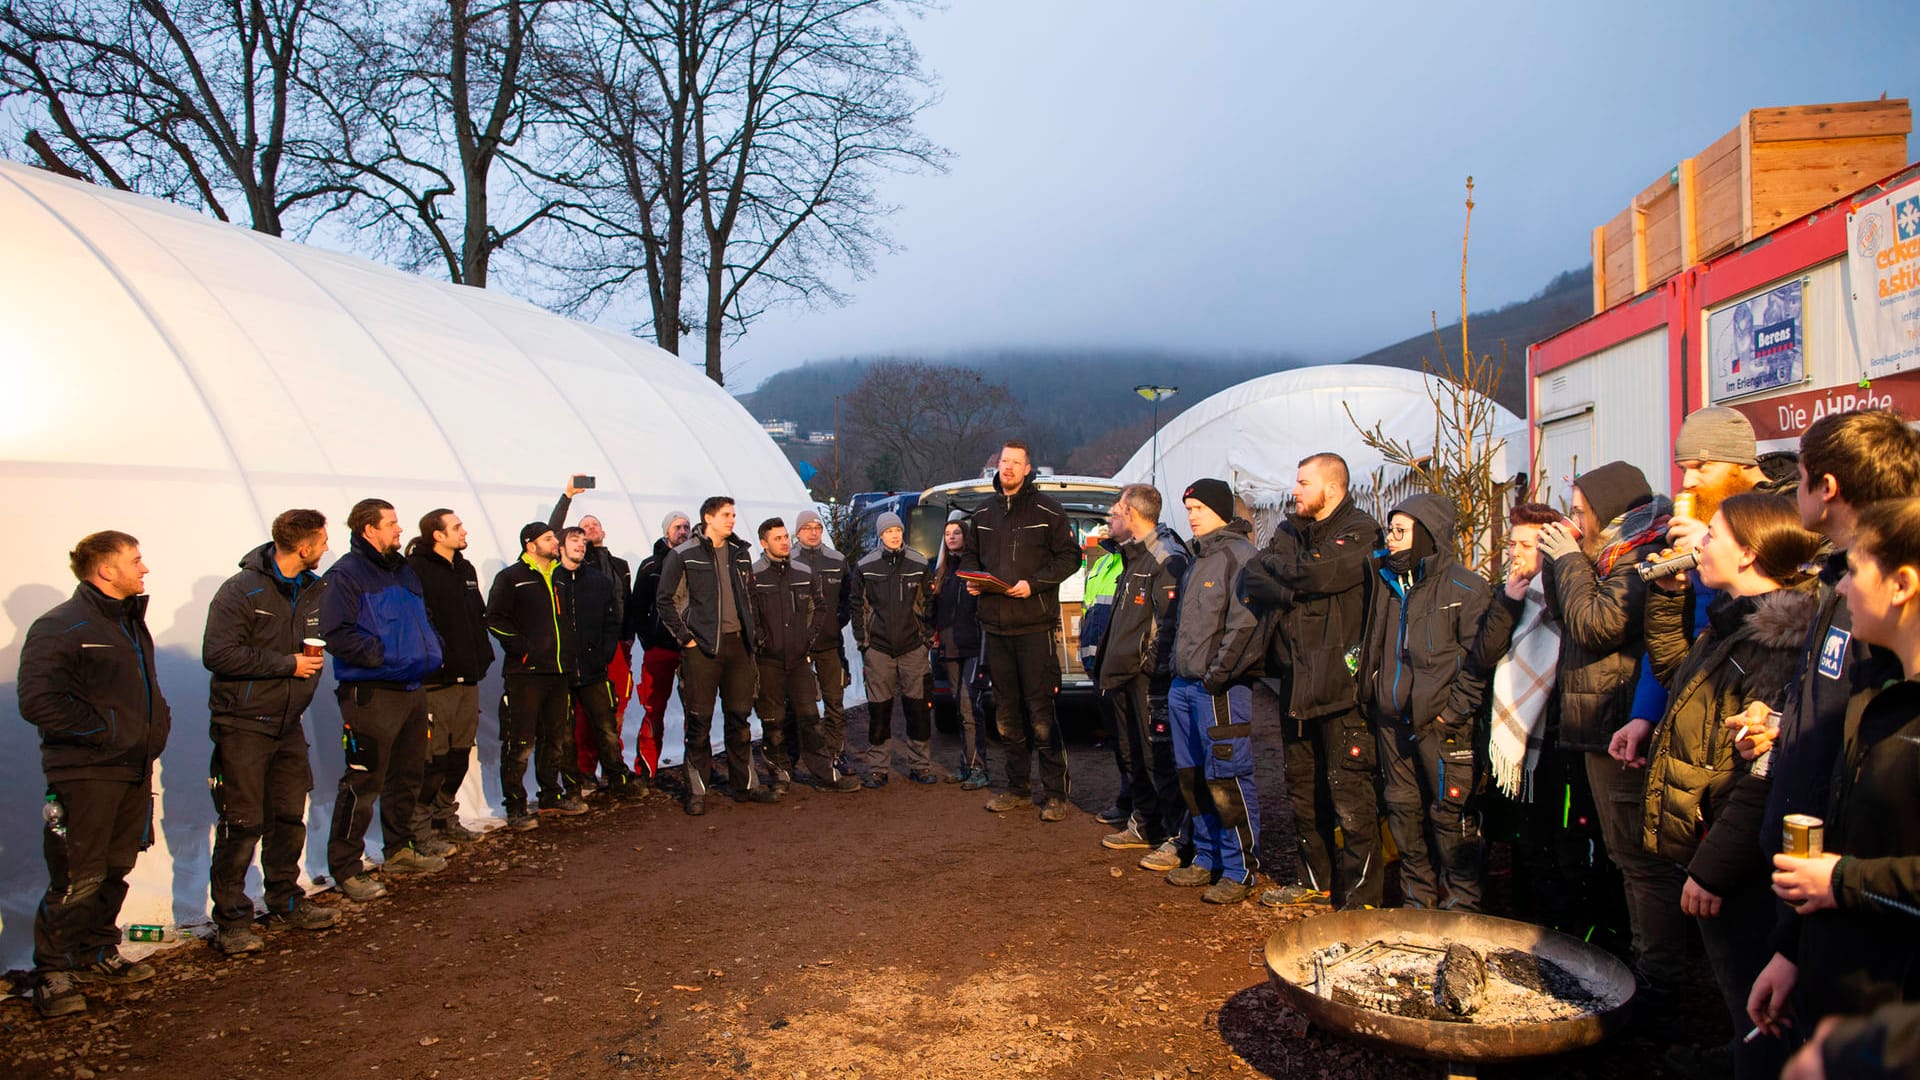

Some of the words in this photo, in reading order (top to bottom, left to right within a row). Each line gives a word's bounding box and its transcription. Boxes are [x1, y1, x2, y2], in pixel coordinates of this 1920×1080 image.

[1758, 327, 1792, 348] Berens
[1726, 381, 1736, 393] Im
[1777, 403, 1807, 431] Die
